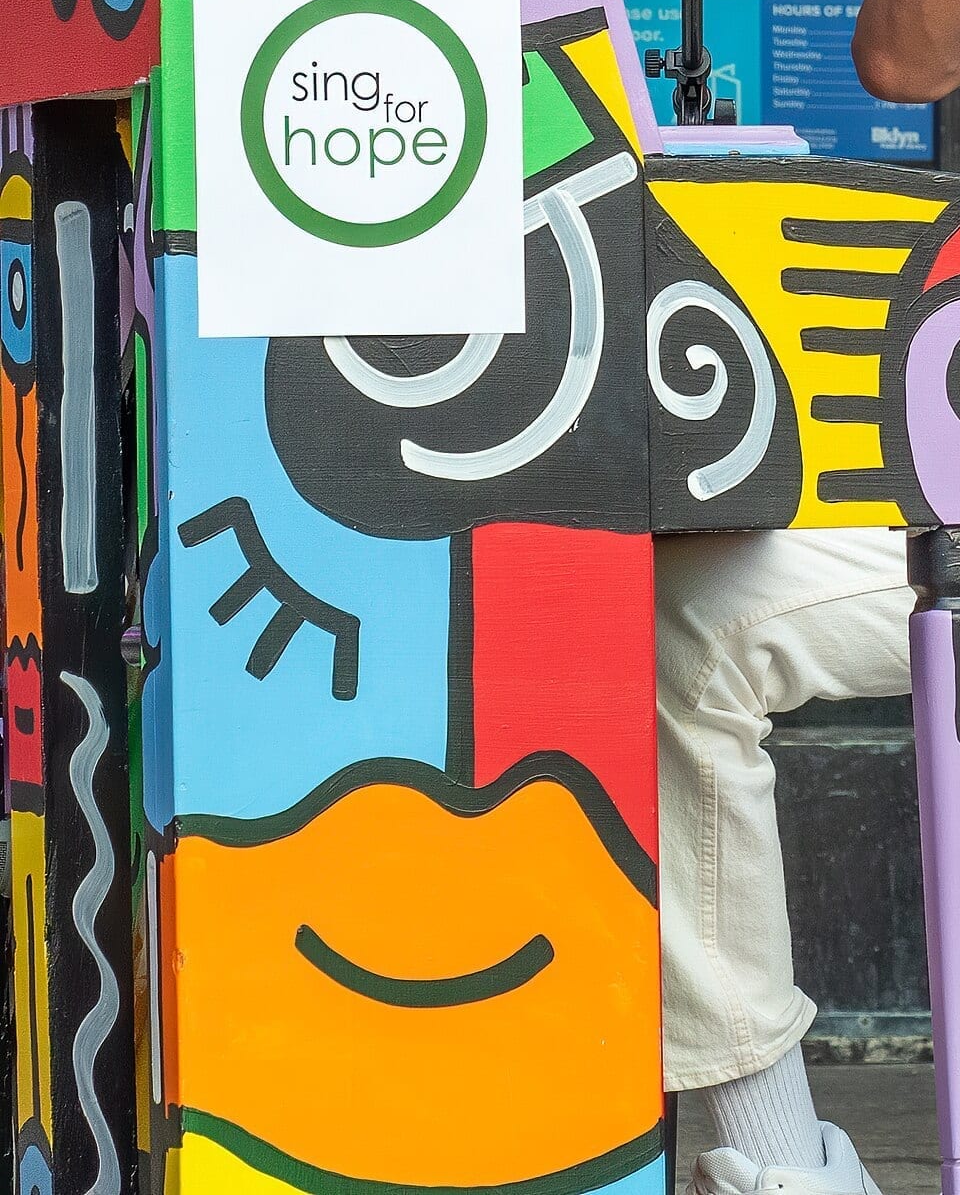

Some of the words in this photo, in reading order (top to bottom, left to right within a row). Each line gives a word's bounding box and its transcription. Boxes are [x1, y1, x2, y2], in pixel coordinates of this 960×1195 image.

[772, 4, 822, 17] HOURS
[823, 4, 844, 17] OF
[772, 25, 807, 36] Monday
[292, 61, 379, 111] sing
[383, 93, 429, 123] for
[284, 115, 448, 178] hope
